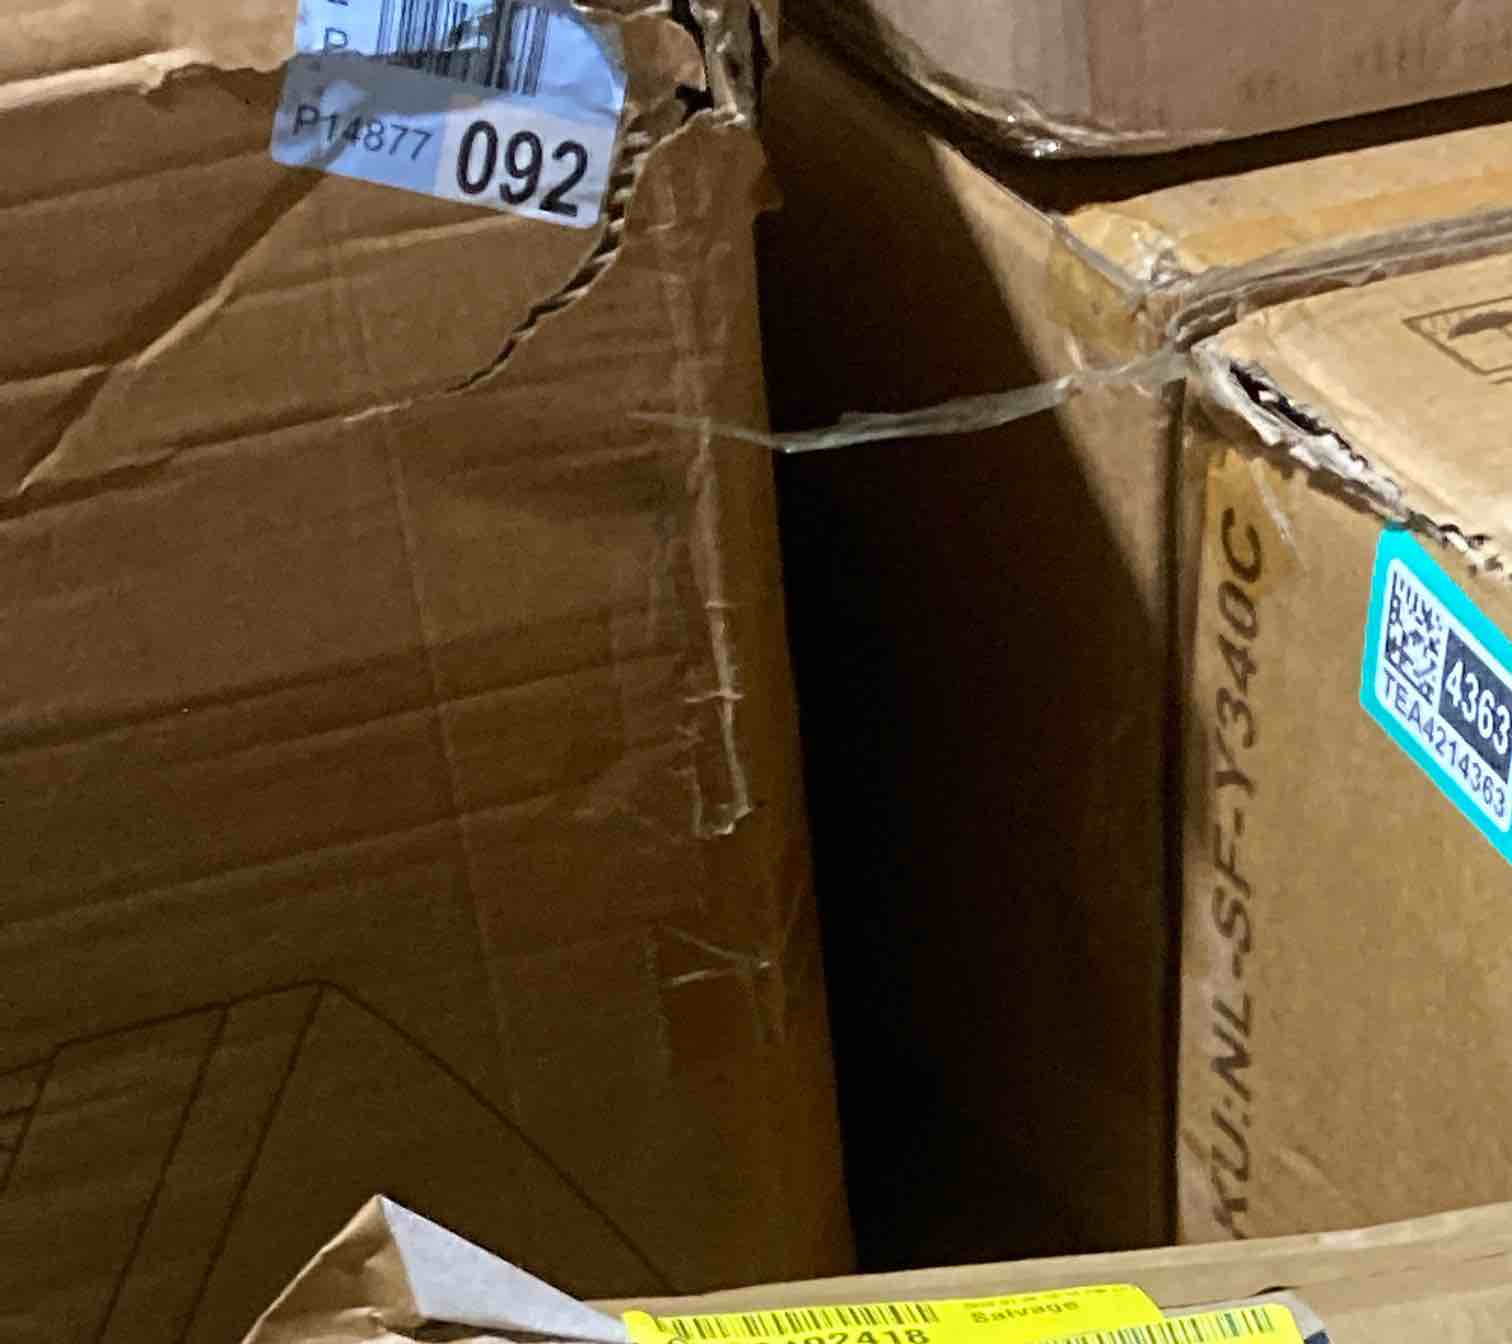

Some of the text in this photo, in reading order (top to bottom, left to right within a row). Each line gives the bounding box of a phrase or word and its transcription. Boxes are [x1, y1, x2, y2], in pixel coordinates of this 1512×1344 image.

[294, 103, 434, 162] P14877
[455, 119, 590, 217] 092
[1383, 666, 1507, 819] TEA4214363
[1444, 659, 1511, 756] 4363
